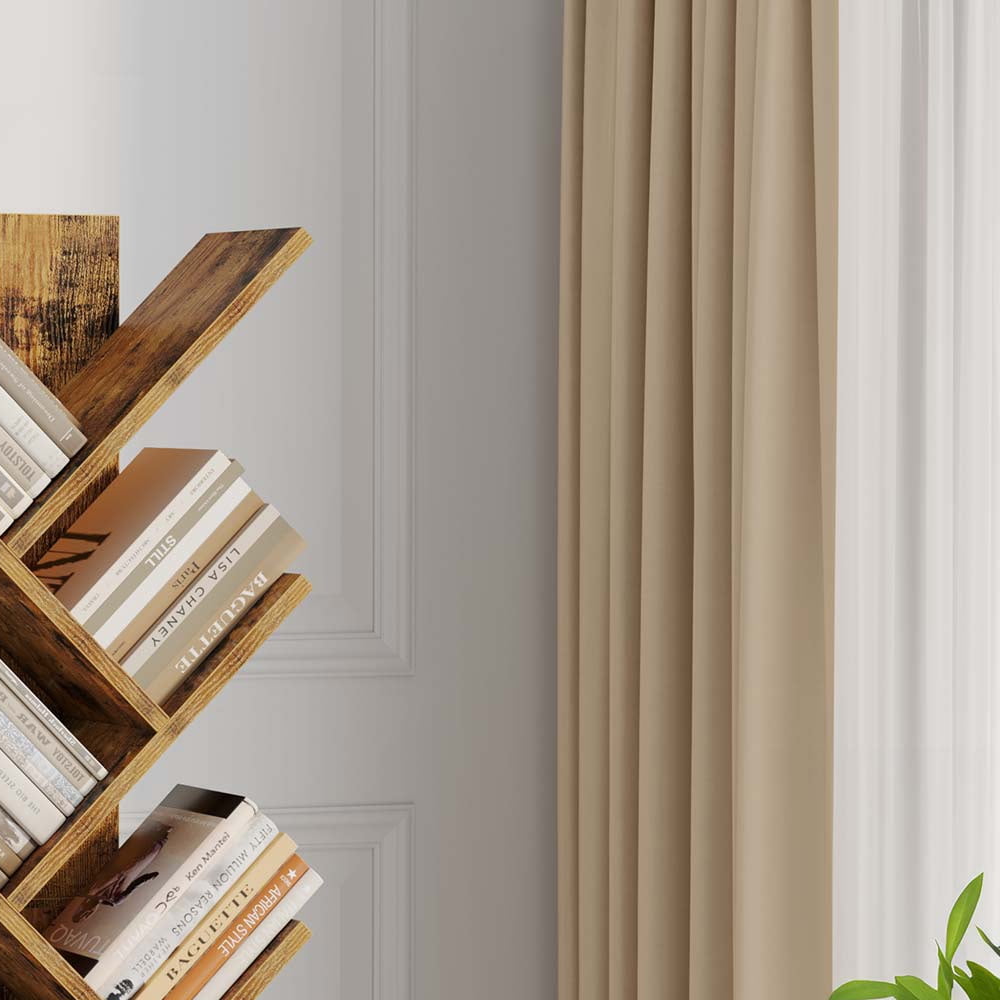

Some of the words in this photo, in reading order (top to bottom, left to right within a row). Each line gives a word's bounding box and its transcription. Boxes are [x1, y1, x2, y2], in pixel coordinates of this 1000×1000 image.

[145, 535, 176, 568] STILL
[208, 548, 239, 581] LISA
[171, 560, 200, 591] Paris
[148, 585, 204, 646] CHANEY
[174, 570, 269, 673] BAGUETTE
[184, 861, 203, 881] Ken
[202, 832, 230, 862] Mantel
[247, 824, 272, 850] FIFTY
[212, 849, 249, 890] MILLION
[171, 890, 213, 936] REASONS
[242, 884, 282, 927] AFRICAN
[165, 884, 253, 980] BAGUETTE
[217, 924, 247, 956] STYLE
[132, 935, 166, 973] WARDELL
